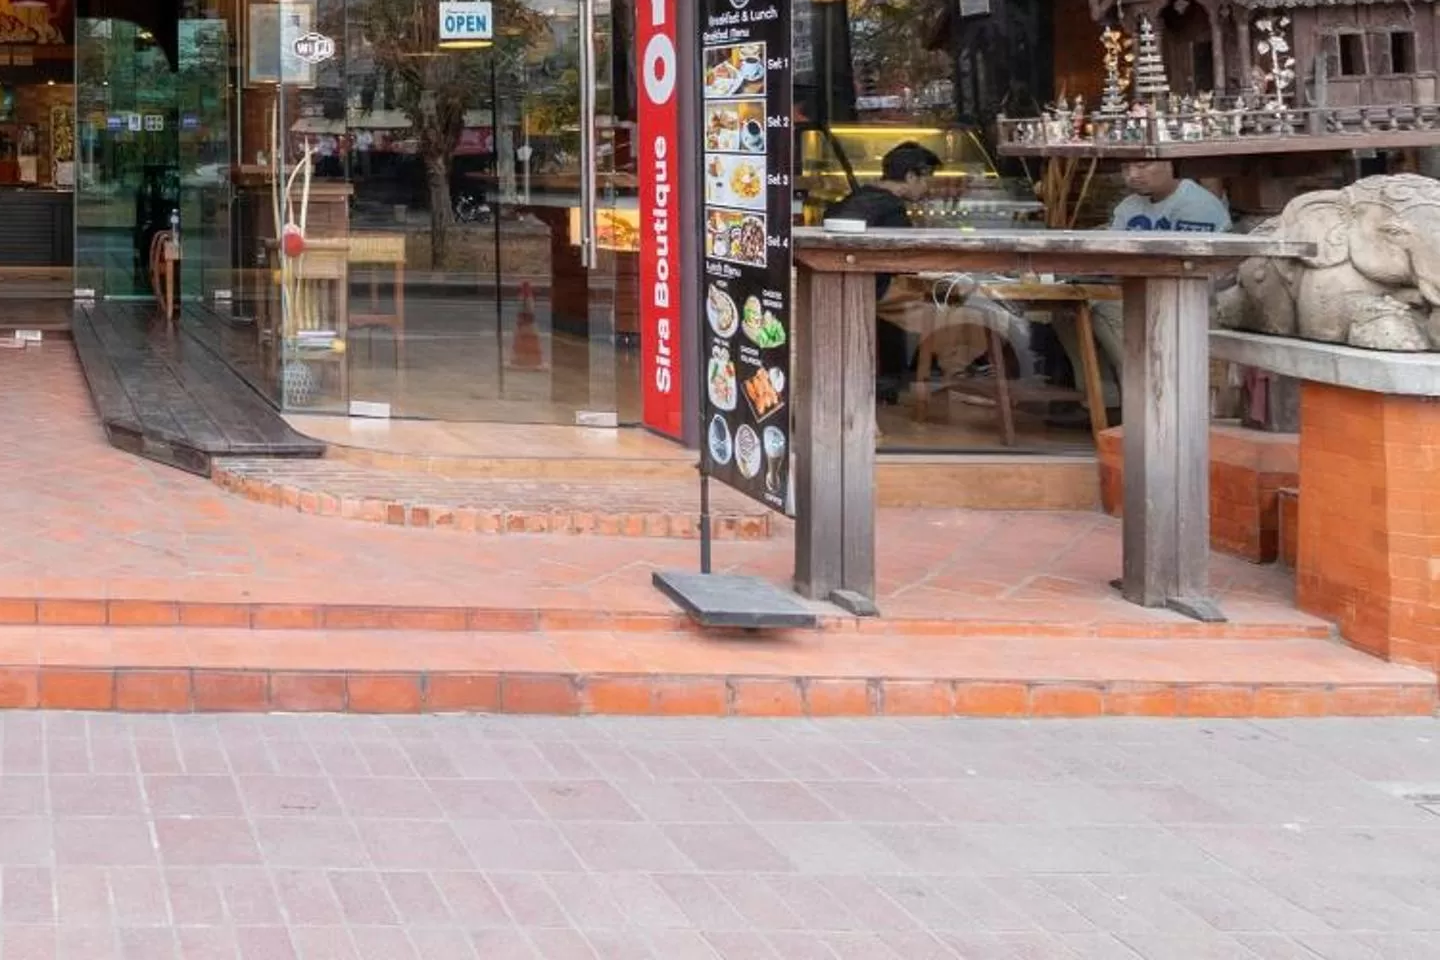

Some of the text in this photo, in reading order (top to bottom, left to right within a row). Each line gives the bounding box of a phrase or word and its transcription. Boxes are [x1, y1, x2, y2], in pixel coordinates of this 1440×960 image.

[445, 15, 487, 32] OPEN
[750, 5, 779, 21] Lunch
[653, 136, 671, 308] Boutique
[655, 318, 672, 394] Sira
